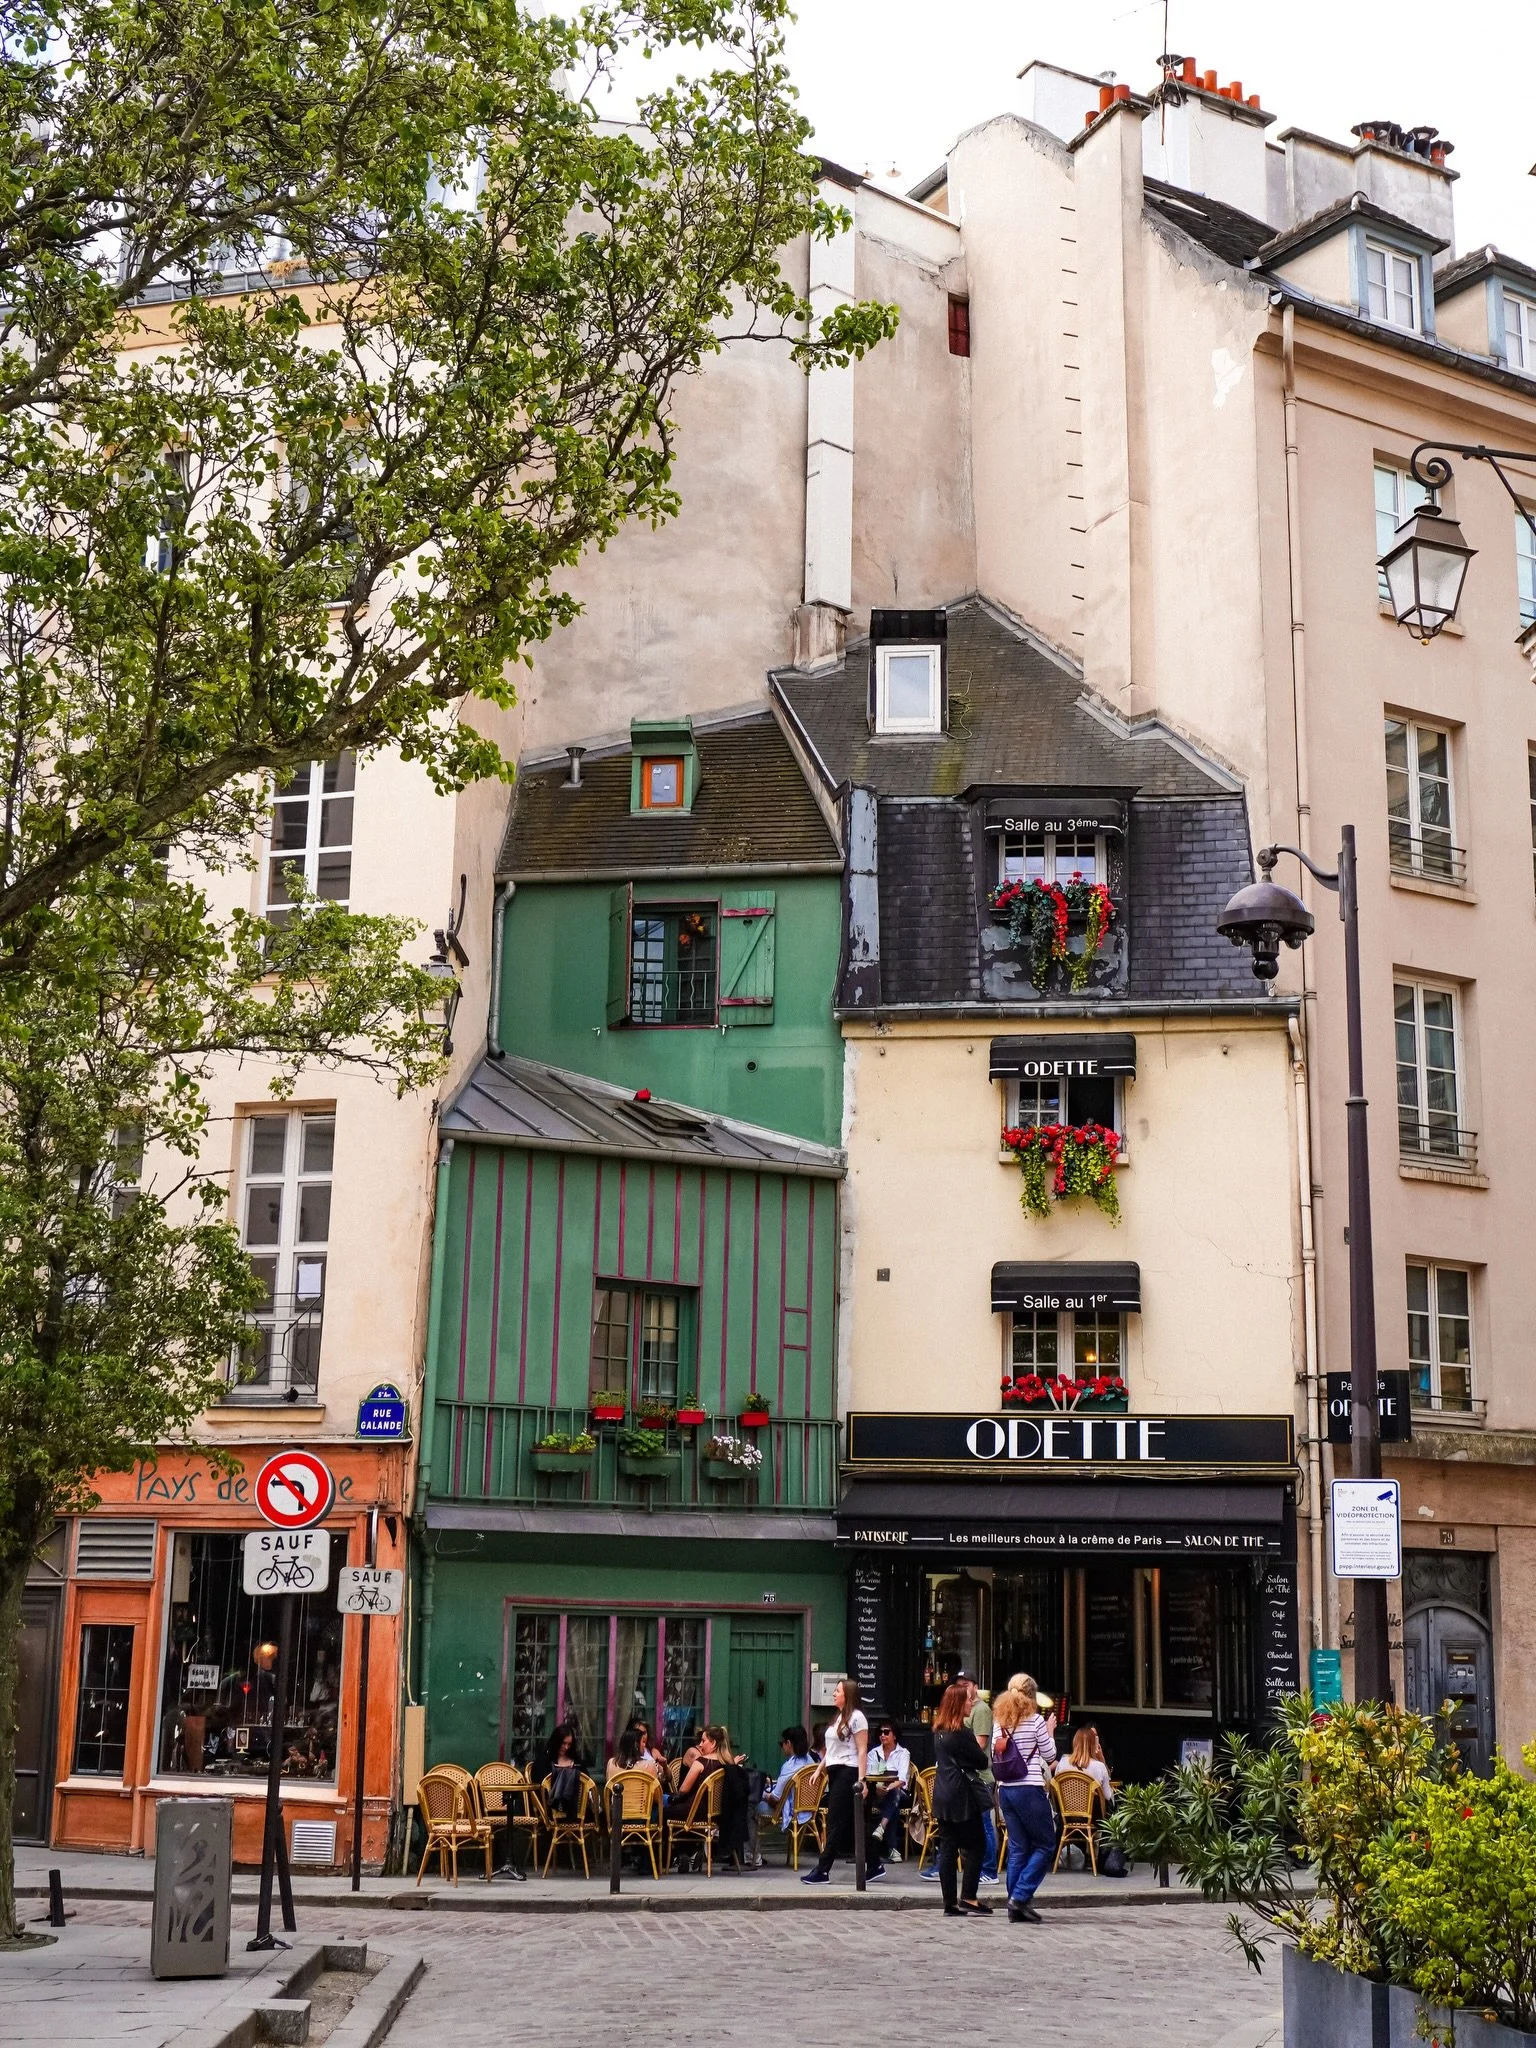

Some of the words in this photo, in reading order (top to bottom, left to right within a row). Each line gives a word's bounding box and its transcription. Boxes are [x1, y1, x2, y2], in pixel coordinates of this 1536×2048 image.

[1004, 818, 1040, 832] Salle
[1044, 821, 1062, 832] au
[1024, 1060, 1098, 1077] ODETTE
[1023, 1295, 1060, 1309] Salle
[1065, 1299, 1083, 1309] au
[1089, 1294, 1108, 1308] 1er
[373, 1408, 392, 1418] RUE
[360, 1420, 402, 1430] GALANDE
[966, 1418, 1166, 1460] ODETTE
[261, 1535, 314, 1551] SAUF
[854, 1531, 909, 1544] PATISSERIE
[949, 1533, 969, 1543] Les
[971, 1533, 1021, 1544] meilleurs
[1023, 1534, 1056, 1544] choux
[1058, 1534, 1066, 1544] à
[1068, 1535, 1078, 1544] la
[1117, 1535, 1131, 1545] de
[1134, 1535, 1162, 1545] Paris
[1184, 1535, 1221, 1547] SALON
[1224, 1536, 1239, 1547] DE
[1442, 1531, 1453, 1543] 79
[352, 1571, 392, 1583] SAUF
[1267, 1574, 1289, 1584] Salon
[1265, 1585, 1274, 1593] de
[1275, 1584, 1290, 1593] Thé
[765, 1594, 774, 1602] 75
[1272, 1610, 1285, 1620] Café
[1267, 1651, 1293, 1659] Chocolat
[1265, 1677, 1284, 1687] Salle
